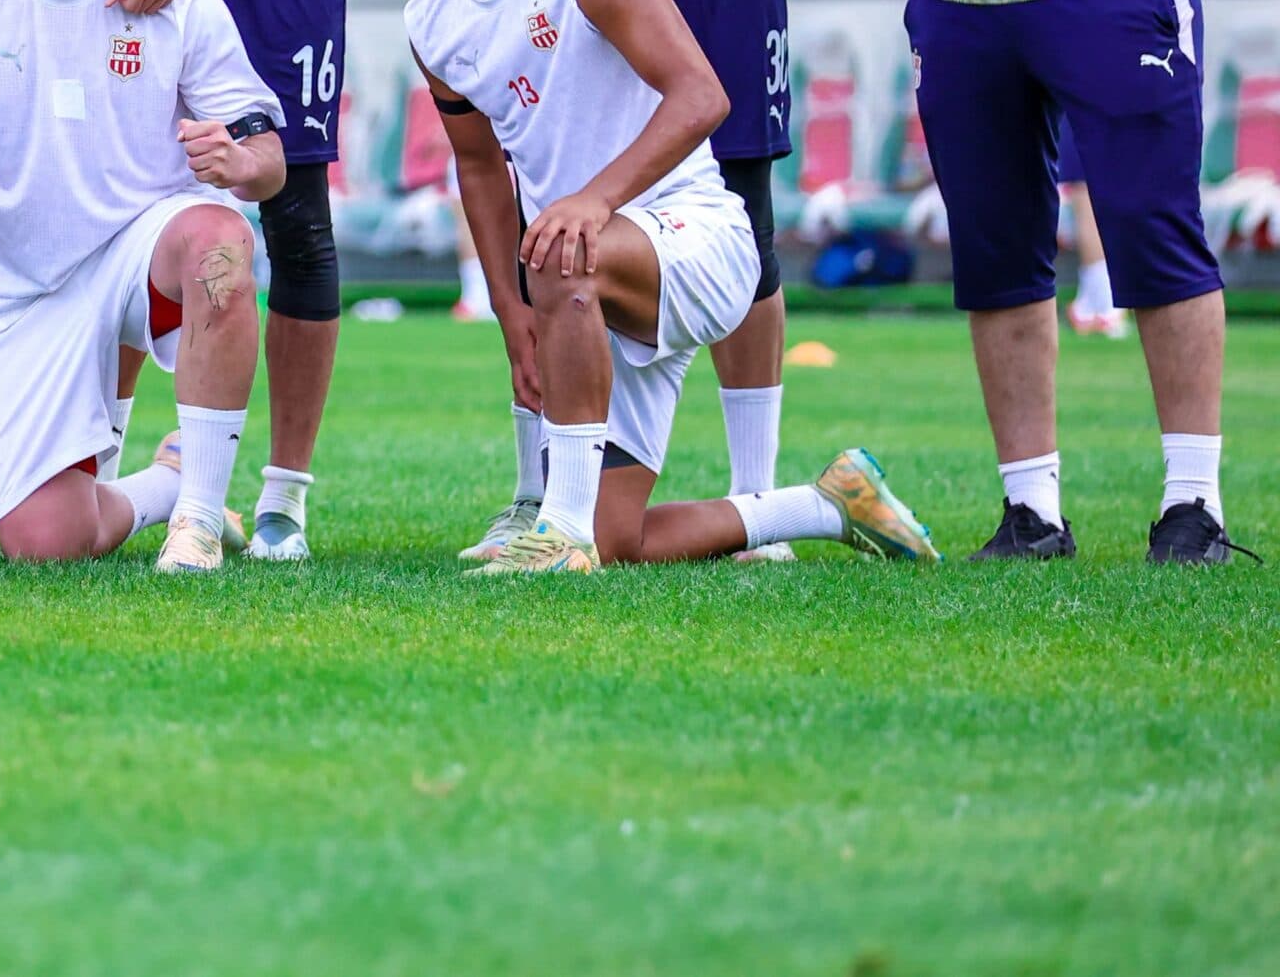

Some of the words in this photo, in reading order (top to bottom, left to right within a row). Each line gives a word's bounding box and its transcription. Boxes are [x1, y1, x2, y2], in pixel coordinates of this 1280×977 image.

[292, 39, 336, 107] 16
[508, 75, 540, 108] 13
[766, 27, 788, 96] 30
